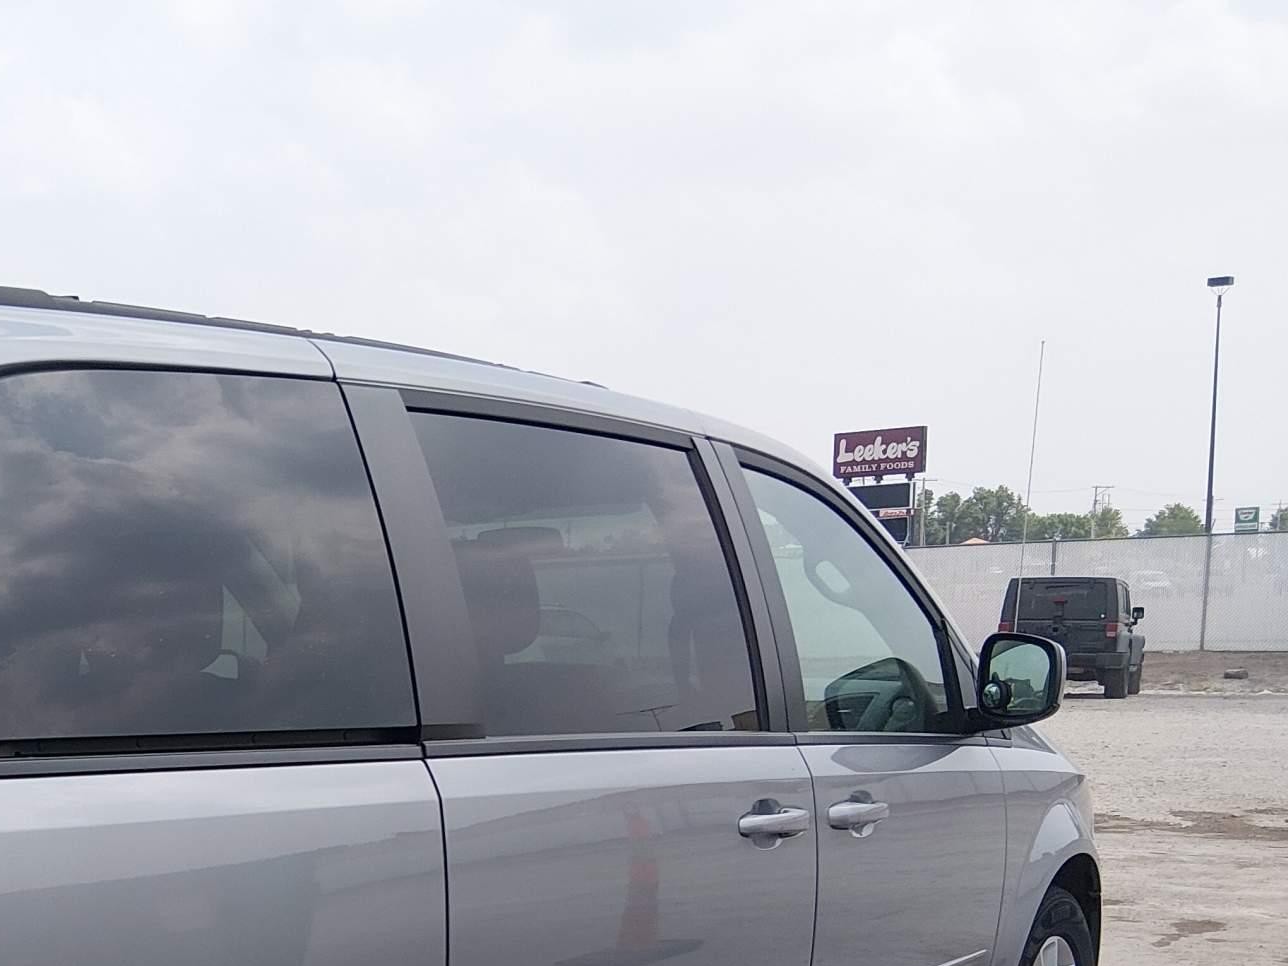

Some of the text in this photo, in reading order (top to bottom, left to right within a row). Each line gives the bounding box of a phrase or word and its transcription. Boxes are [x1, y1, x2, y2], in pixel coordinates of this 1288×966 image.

[836, 436, 920, 463] Leeker's
[840, 461, 915, 474] FAMILY FOODS
